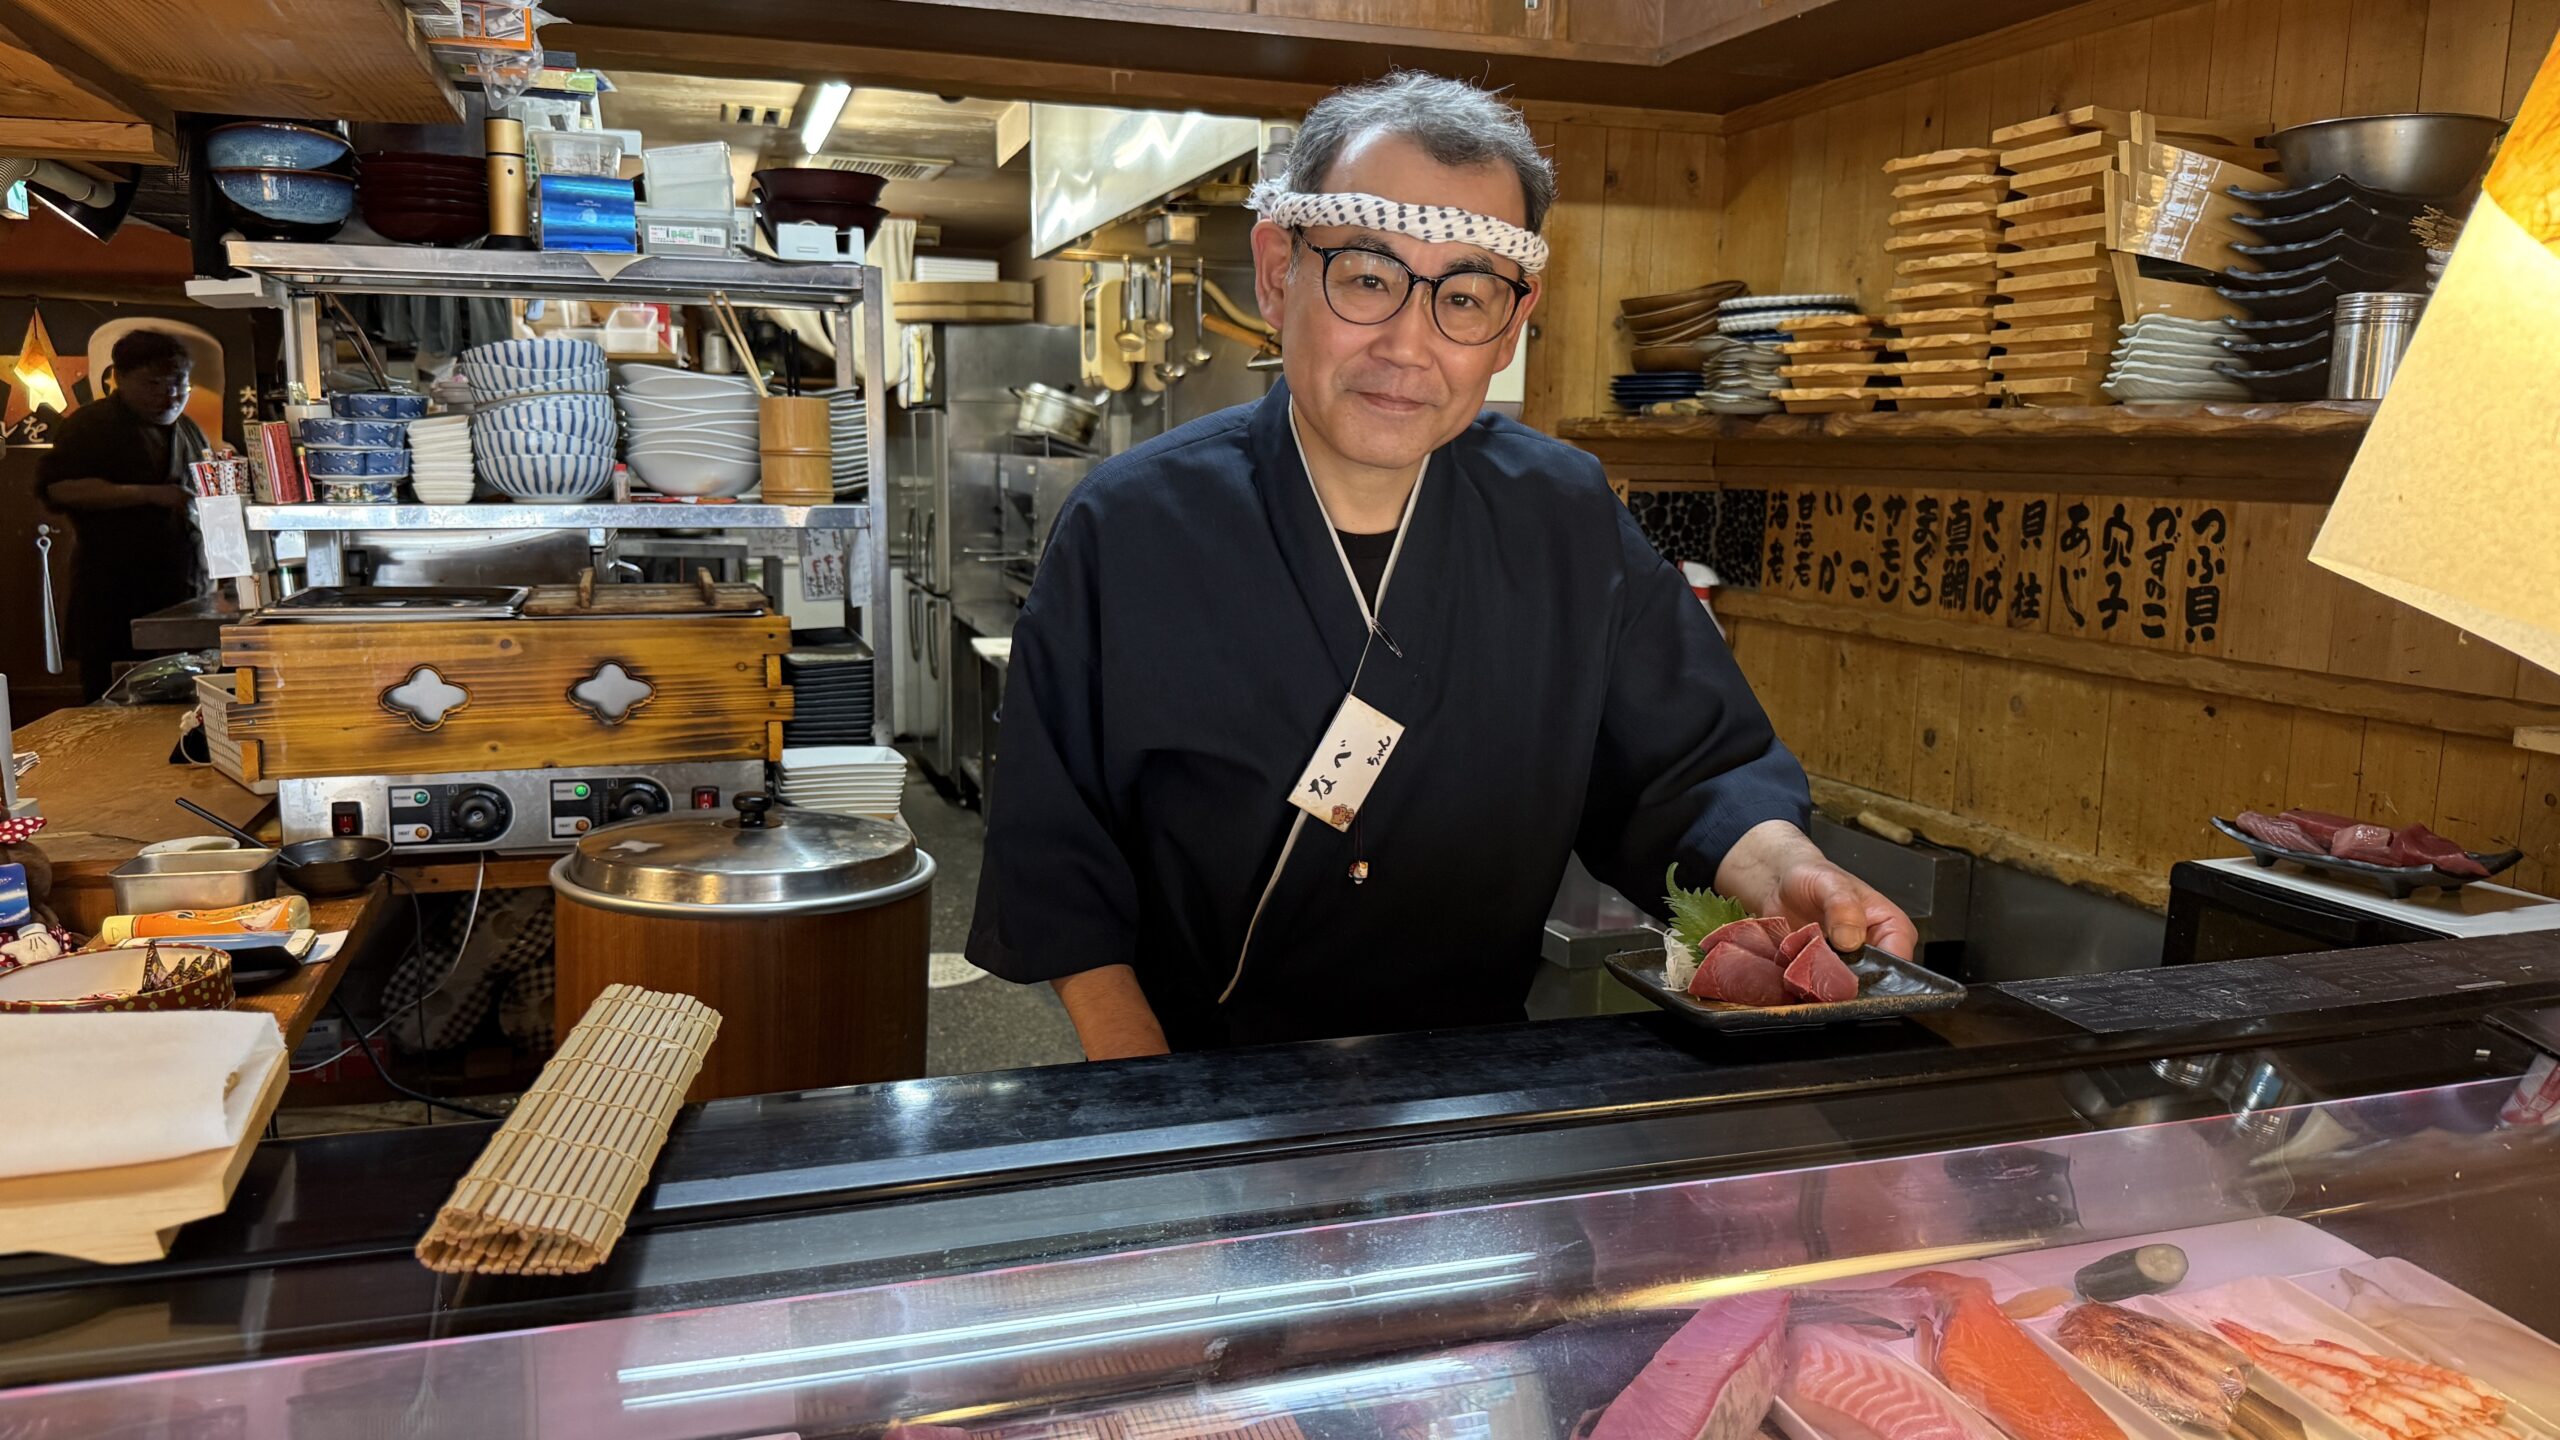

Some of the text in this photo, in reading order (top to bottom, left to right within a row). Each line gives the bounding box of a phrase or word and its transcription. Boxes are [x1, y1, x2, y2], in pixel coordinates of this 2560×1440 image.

[1819, 491, 1842, 594] いか
[1850, 493, 1875, 599] たこ
[1878, 494, 1907, 603] サーモン
[1908, 495, 1939, 607] まぐろ
[1940, 496, 1971, 612] 真鯛
[1974, 498, 2005, 616] さば
[2060, 501, 2091, 628] あじ
[2097, 503, 2134, 631] 穴子
[2185, 508, 2226, 644] つぶ貝
[1308, 739, 1352, 800] なべ
[1366, 735, 1392, 766] ちゃん
